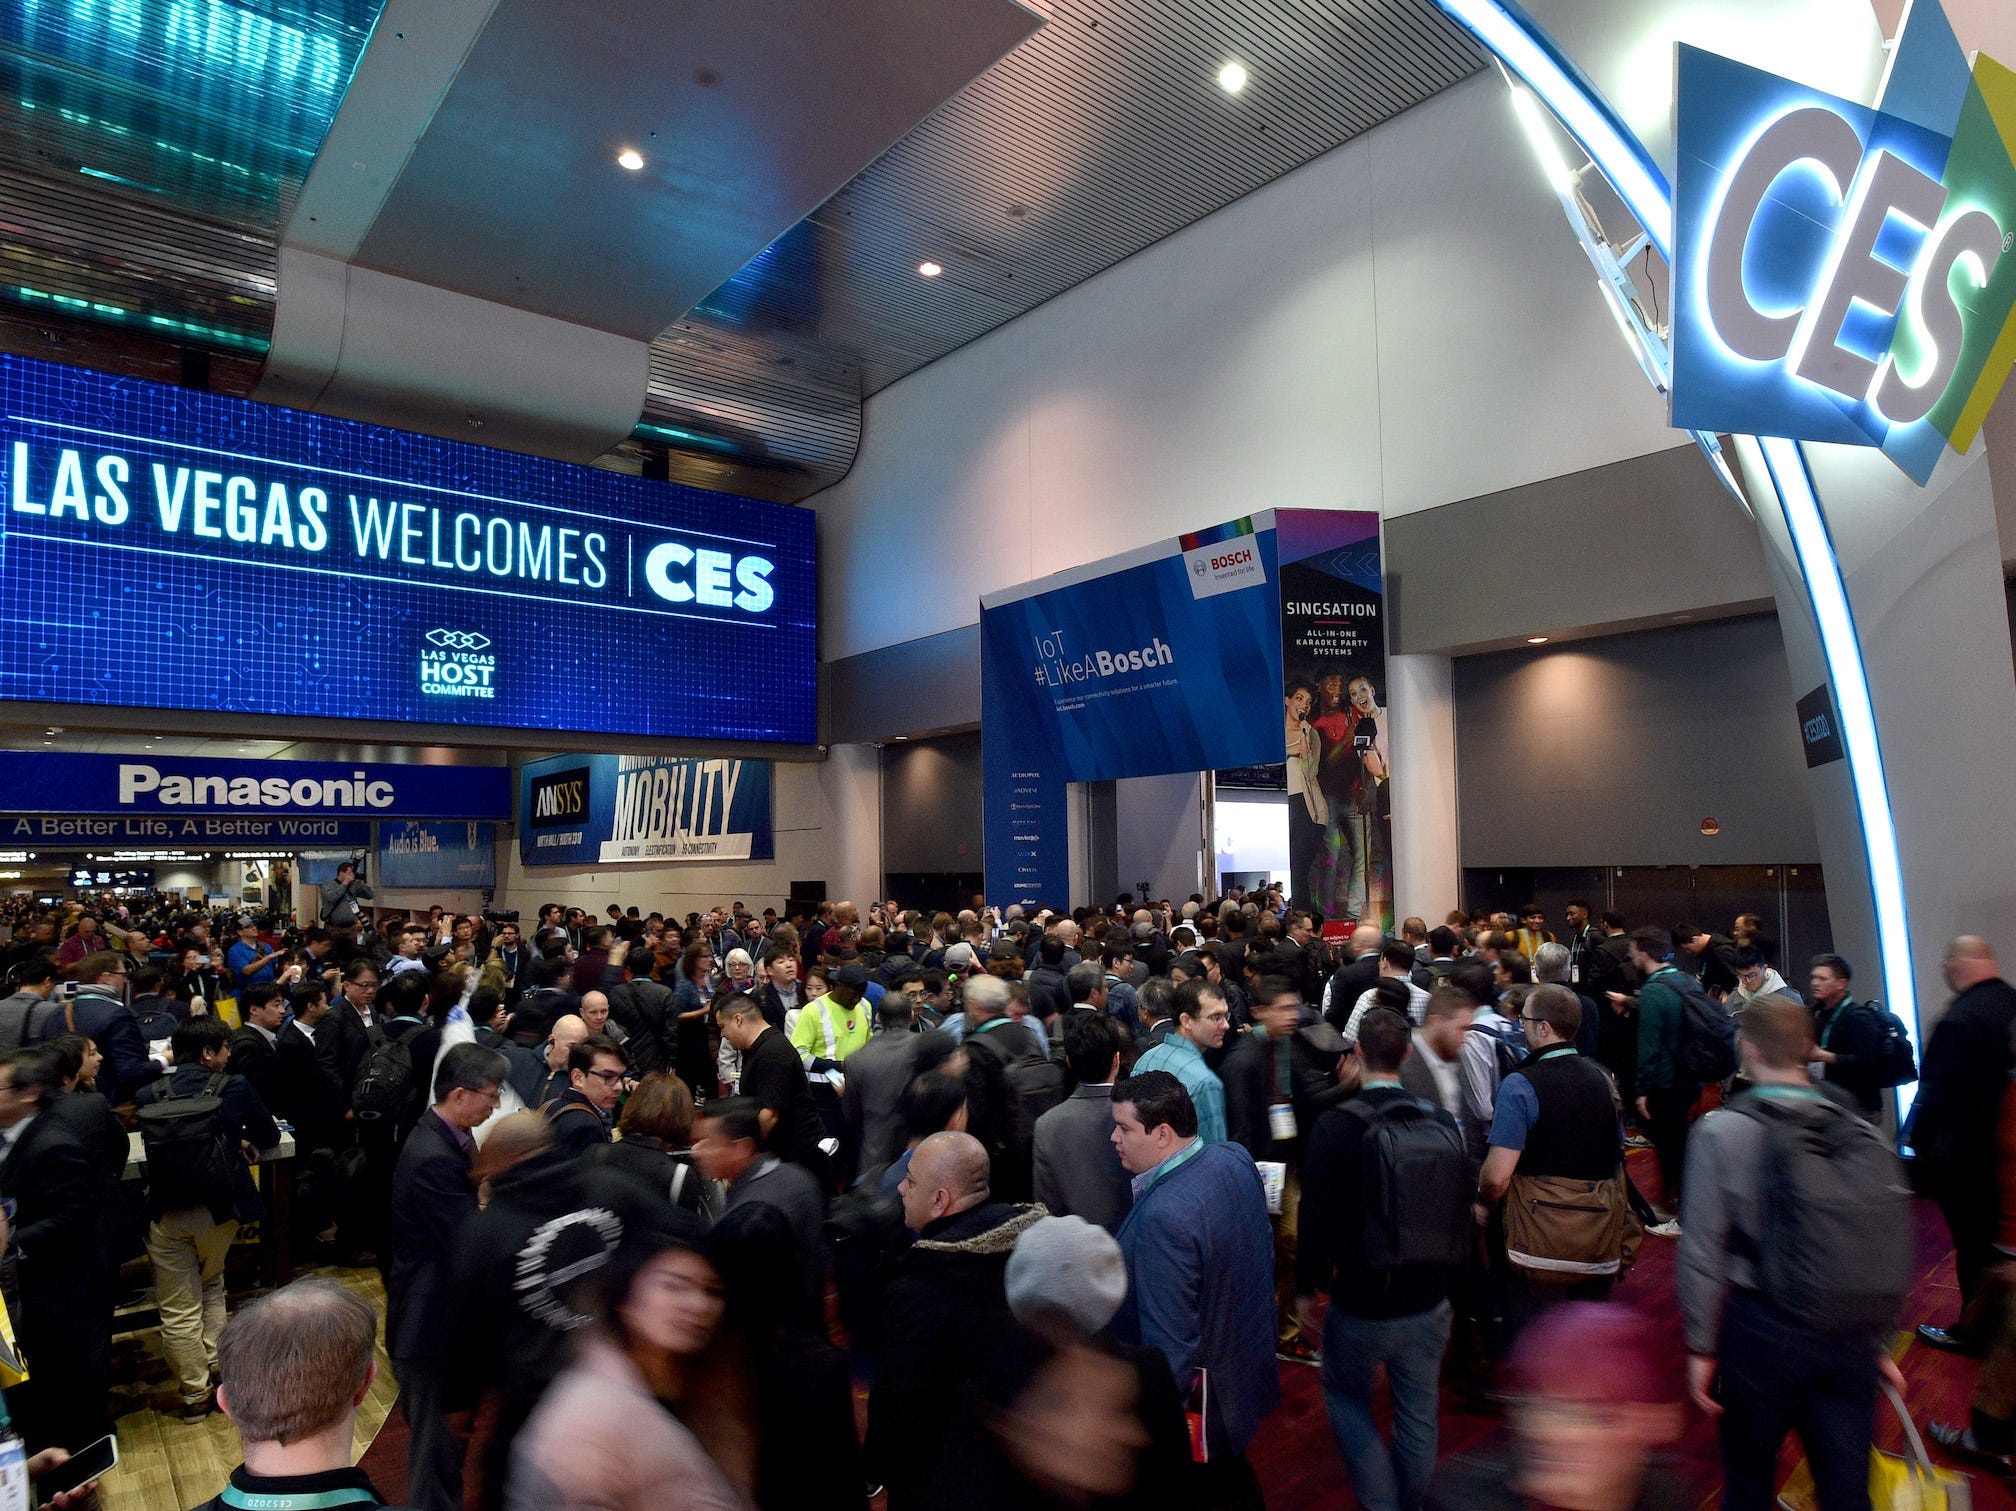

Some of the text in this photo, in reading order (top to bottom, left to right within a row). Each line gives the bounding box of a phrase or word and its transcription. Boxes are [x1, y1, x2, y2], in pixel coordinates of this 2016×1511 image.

[1706, 107, 2003, 423] CES
[13, 441, 775, 613] LAS VEGAS WELCOMES CES
[1211, 549, 1252, 570] BOSCH
[1286, 602, 1376, 617] SINGSATION
[1034, 630, 1065, 659] IoT
[1313, 648, 1353, 656] SYSTEMS
[421, 649, 495, 665] LAS VEGAS
[1034, 637, 1174, 686] #LikeABosch
[421, 661, 495, 686] HOST
[421, 683, 495, 698] COMMITTEE
[119, 764, 395, 808] Panasonic
[536, 780, 583, 818] ANSYS
[612, 759, 742, 841] MOBILITY
[13, 818, 338, 838] A Better Life, A Better World
[389, 832, 411, 855] Audio
[412, 832, 418, 853] is
[248, 1499, 293, 1508] CES2020
